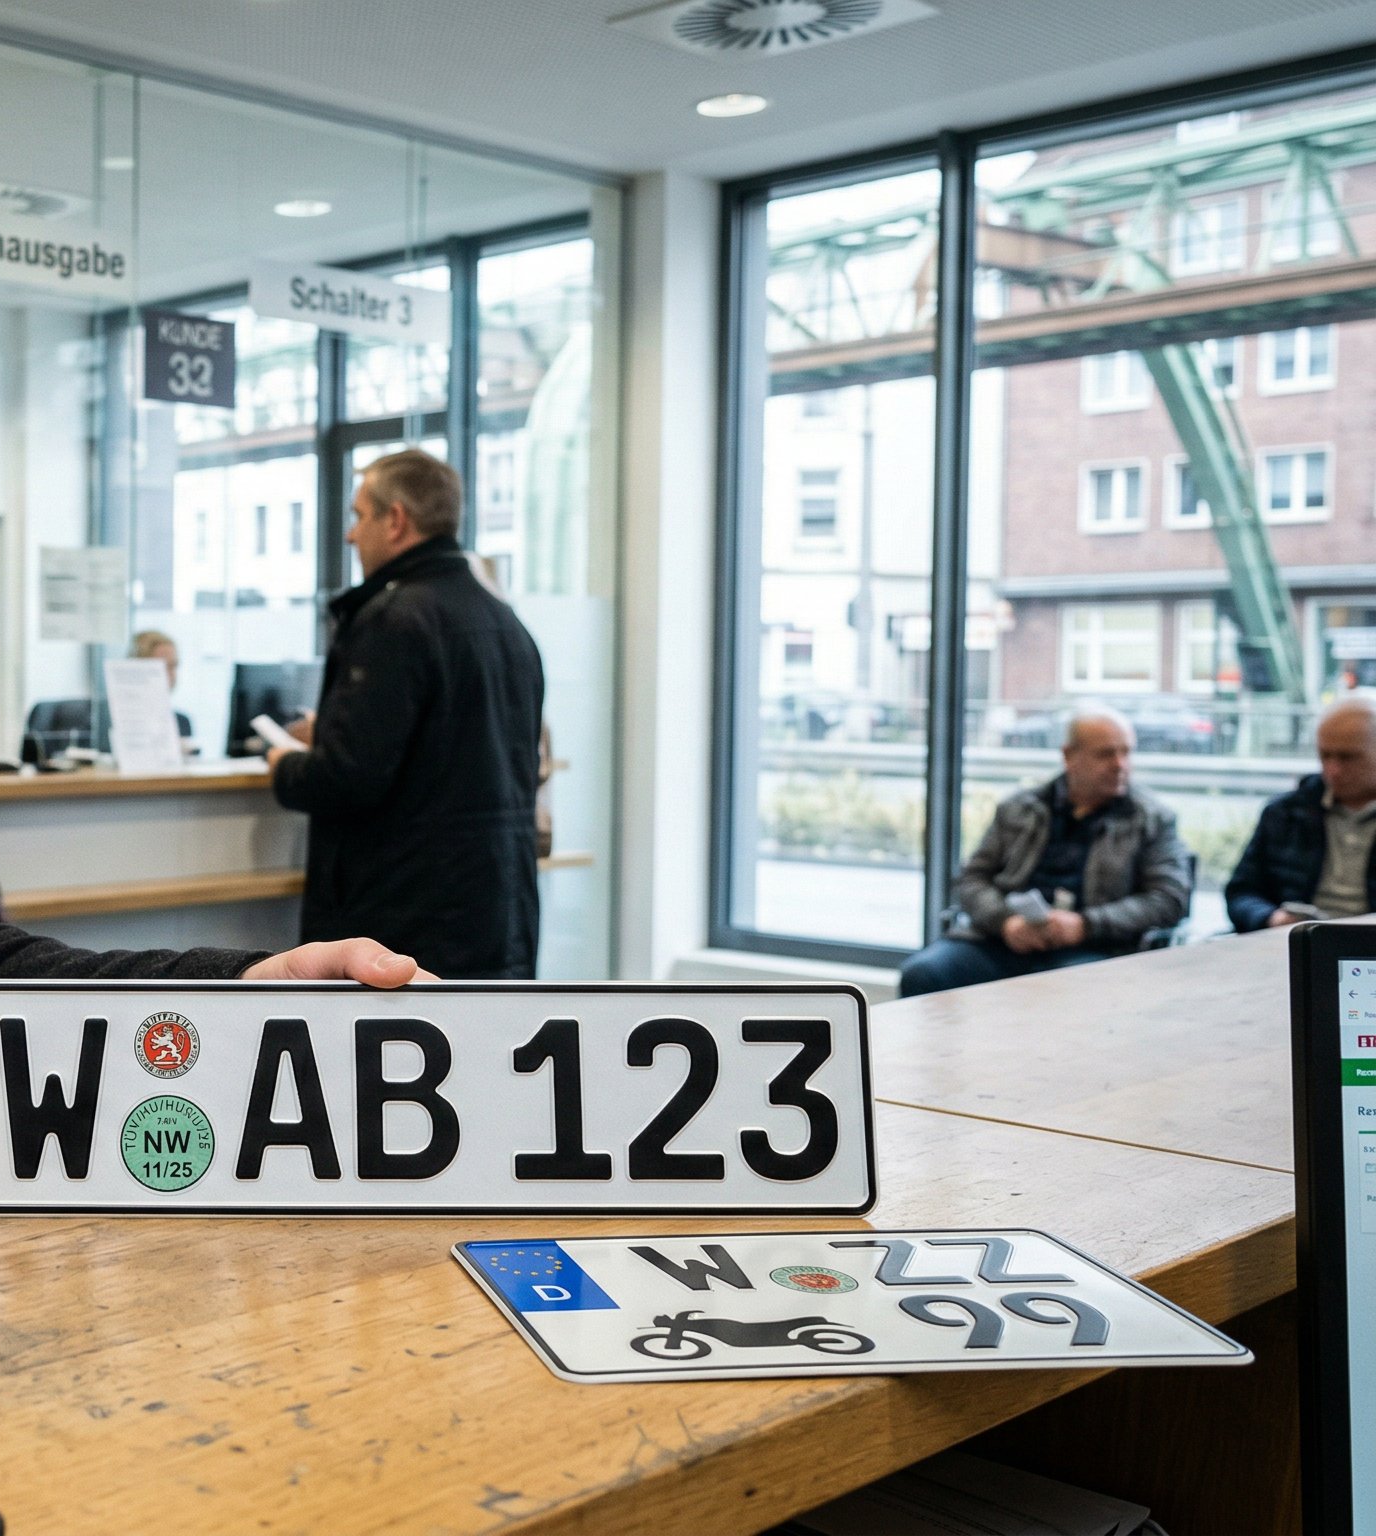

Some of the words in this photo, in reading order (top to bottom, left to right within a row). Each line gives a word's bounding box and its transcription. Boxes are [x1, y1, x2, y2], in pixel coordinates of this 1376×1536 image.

[289, 276, 390, 322] Schalter
[398, 295, 412, 326] 3
[157, 317, 221, 351] KUNDE
[167, 352, 212, 398] 32
[0, 1017, 109, 1181] W
[234, 1017, 462, 1181] AB
[511, 1017, 840, 1182] 123
[144, 1130, 191, 1154] NW
[142, 1161, 193, 1178] 11/25
[627, 1244, 755, 1291] W
[532, 1285, 572, 1301] D
